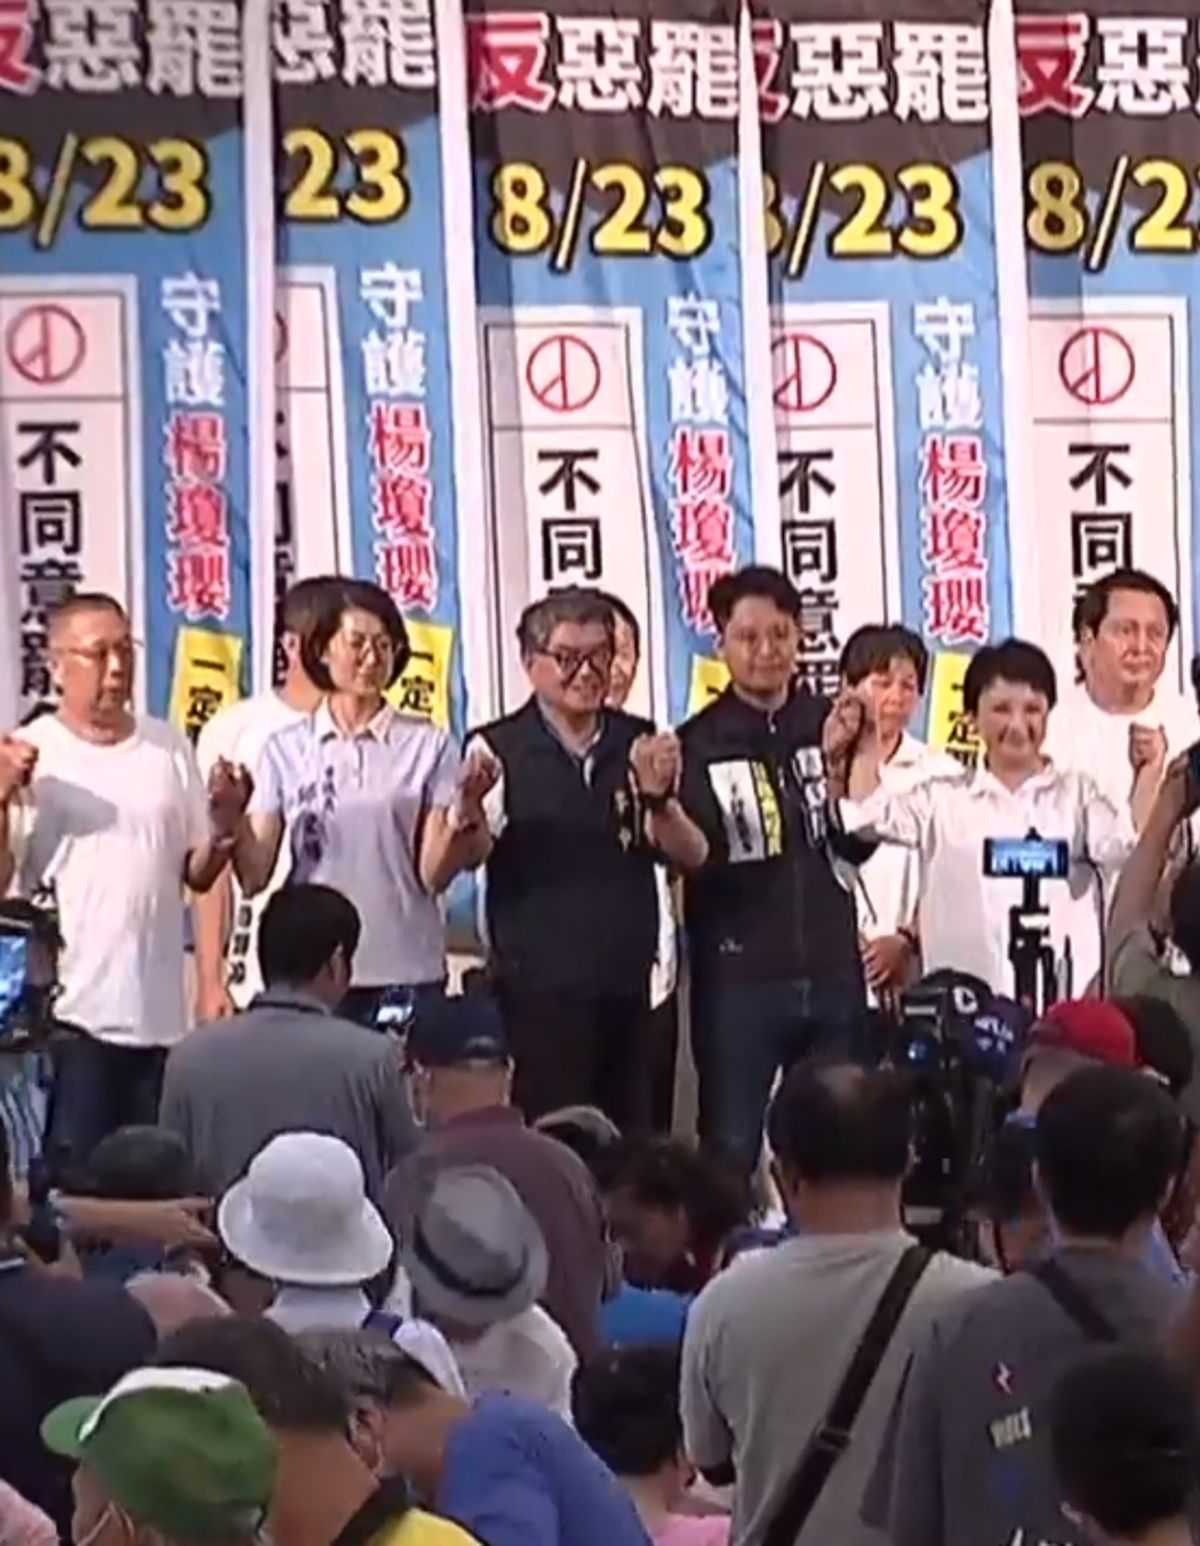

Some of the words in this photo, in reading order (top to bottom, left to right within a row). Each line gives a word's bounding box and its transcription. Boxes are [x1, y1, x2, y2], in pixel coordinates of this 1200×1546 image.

[470, 12, 740, 117] 反惡罷
[490, 156, 712, 274] 8/23
[161, 271, 231, 621] 守護楊瓊瓔
[360, 262, 438, 613] 守護楊瓊瓔
[538, 449, 602, 600] 不同
[914, 298, 990, 645] 守護楊瓊瓔
[1069, 443, 1133, 602] 不同
[17, 421, 84, 727] 不同意
